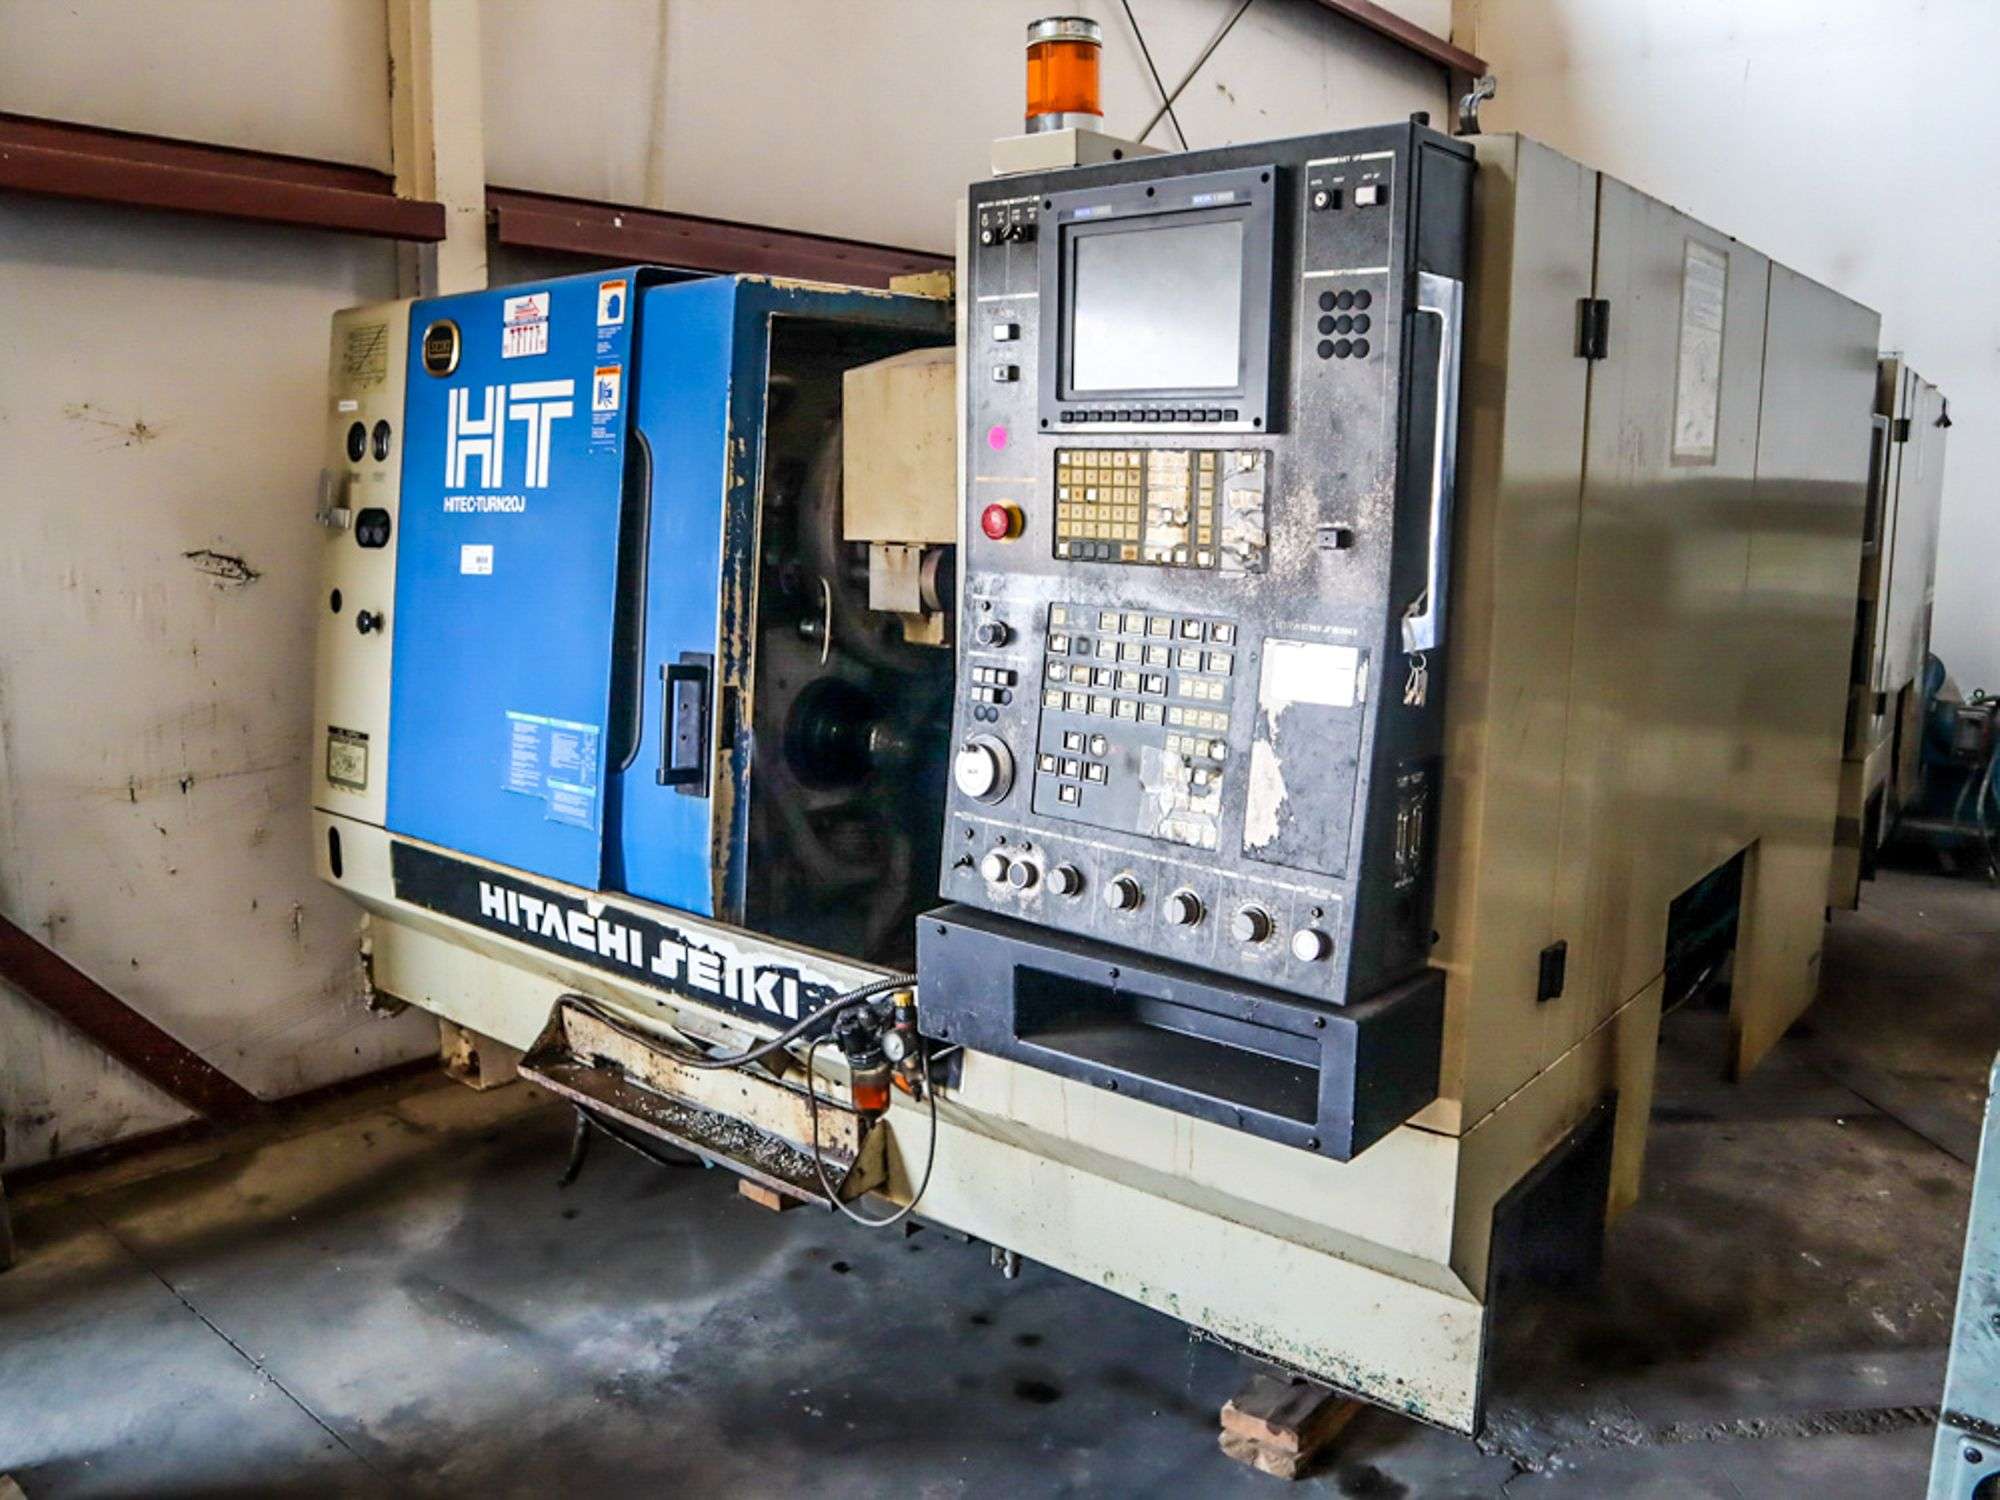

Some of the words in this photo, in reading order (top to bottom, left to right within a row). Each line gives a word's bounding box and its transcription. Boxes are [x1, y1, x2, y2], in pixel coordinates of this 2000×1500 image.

[445, 378, 575, 489] HT
[479, 880, 644, 969] HITACHI
[651, 938, 800, 1021] SEIKI
